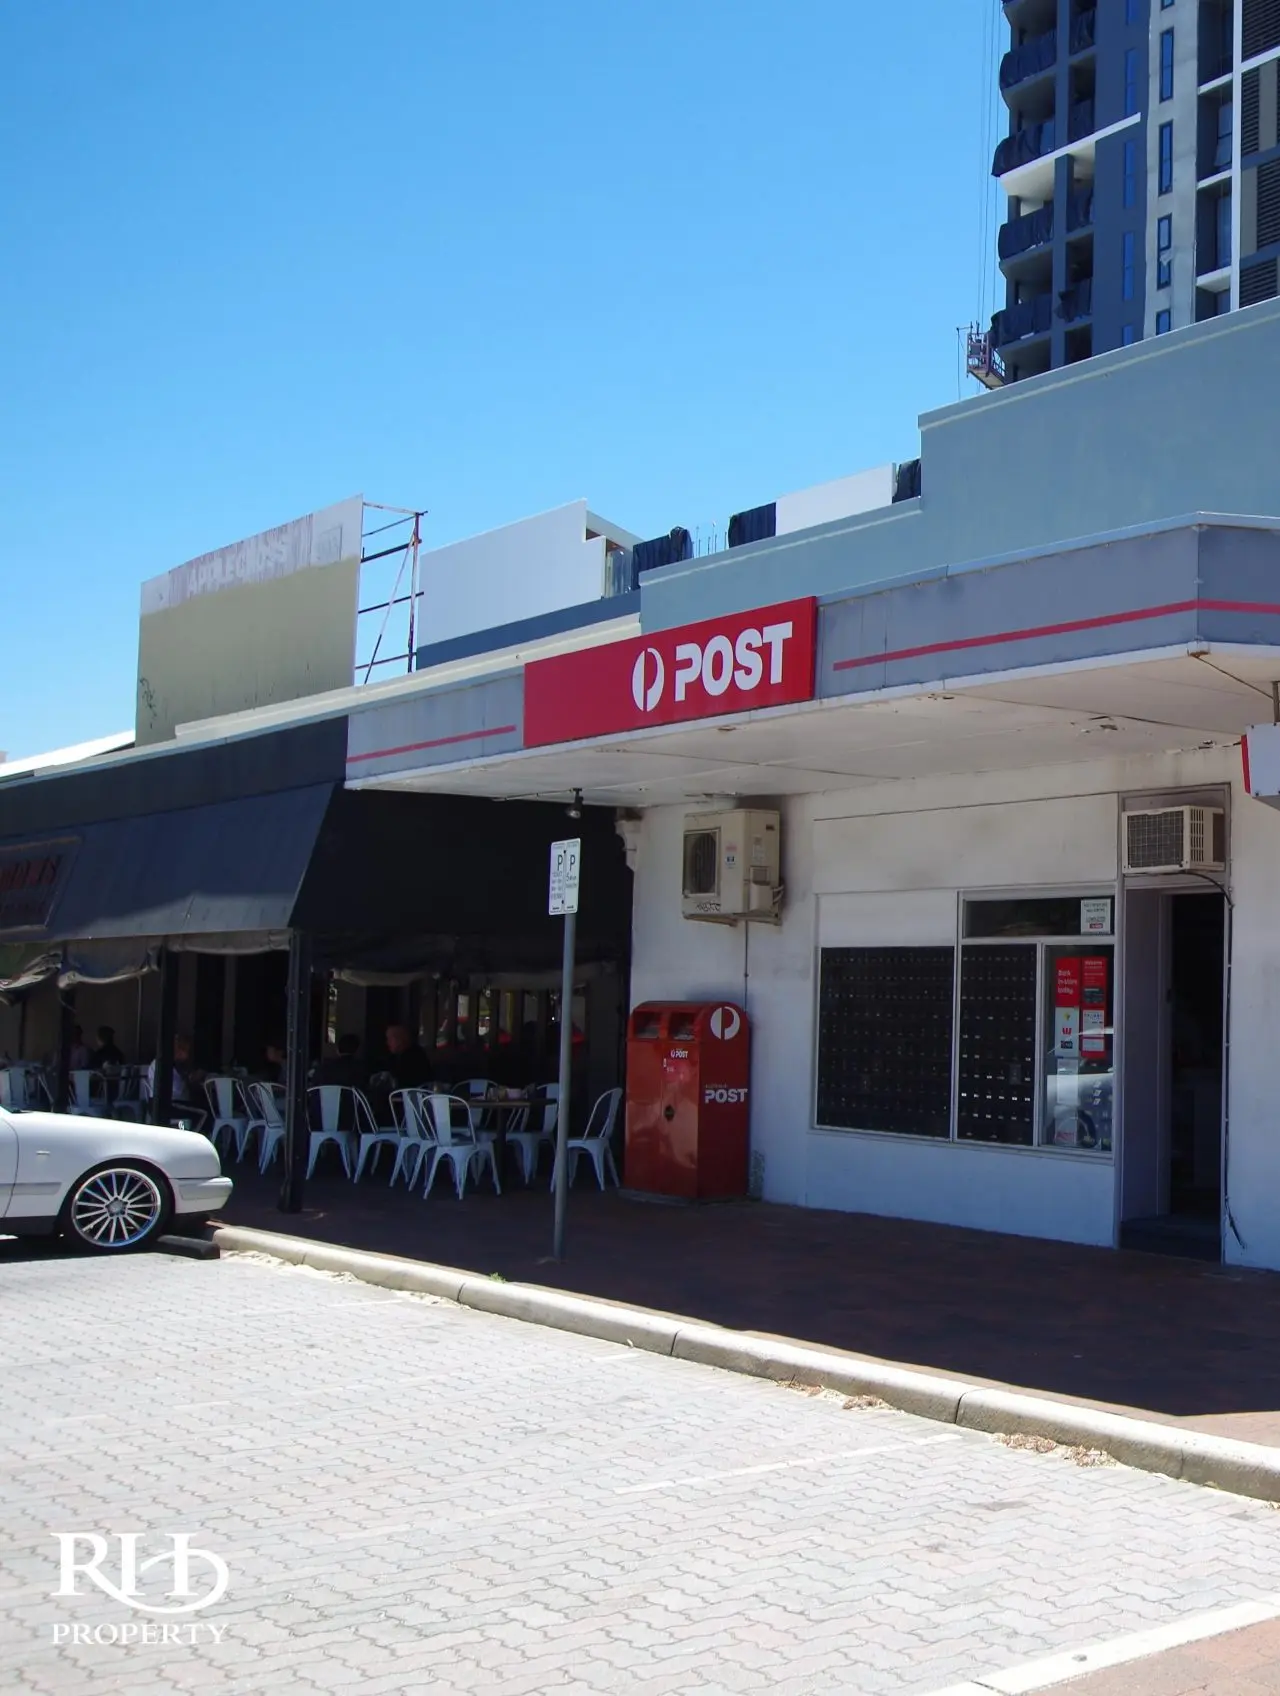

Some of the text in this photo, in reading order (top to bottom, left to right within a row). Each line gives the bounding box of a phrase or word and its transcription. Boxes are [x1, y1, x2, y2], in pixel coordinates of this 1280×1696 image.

[675, 621, 793, 702] POST
[557, 854, 564, 871] P
[569, 854, 576, 871] P
[675, 1050, 689, 1059] POST
[704, 1088, 748, 1104] POST
